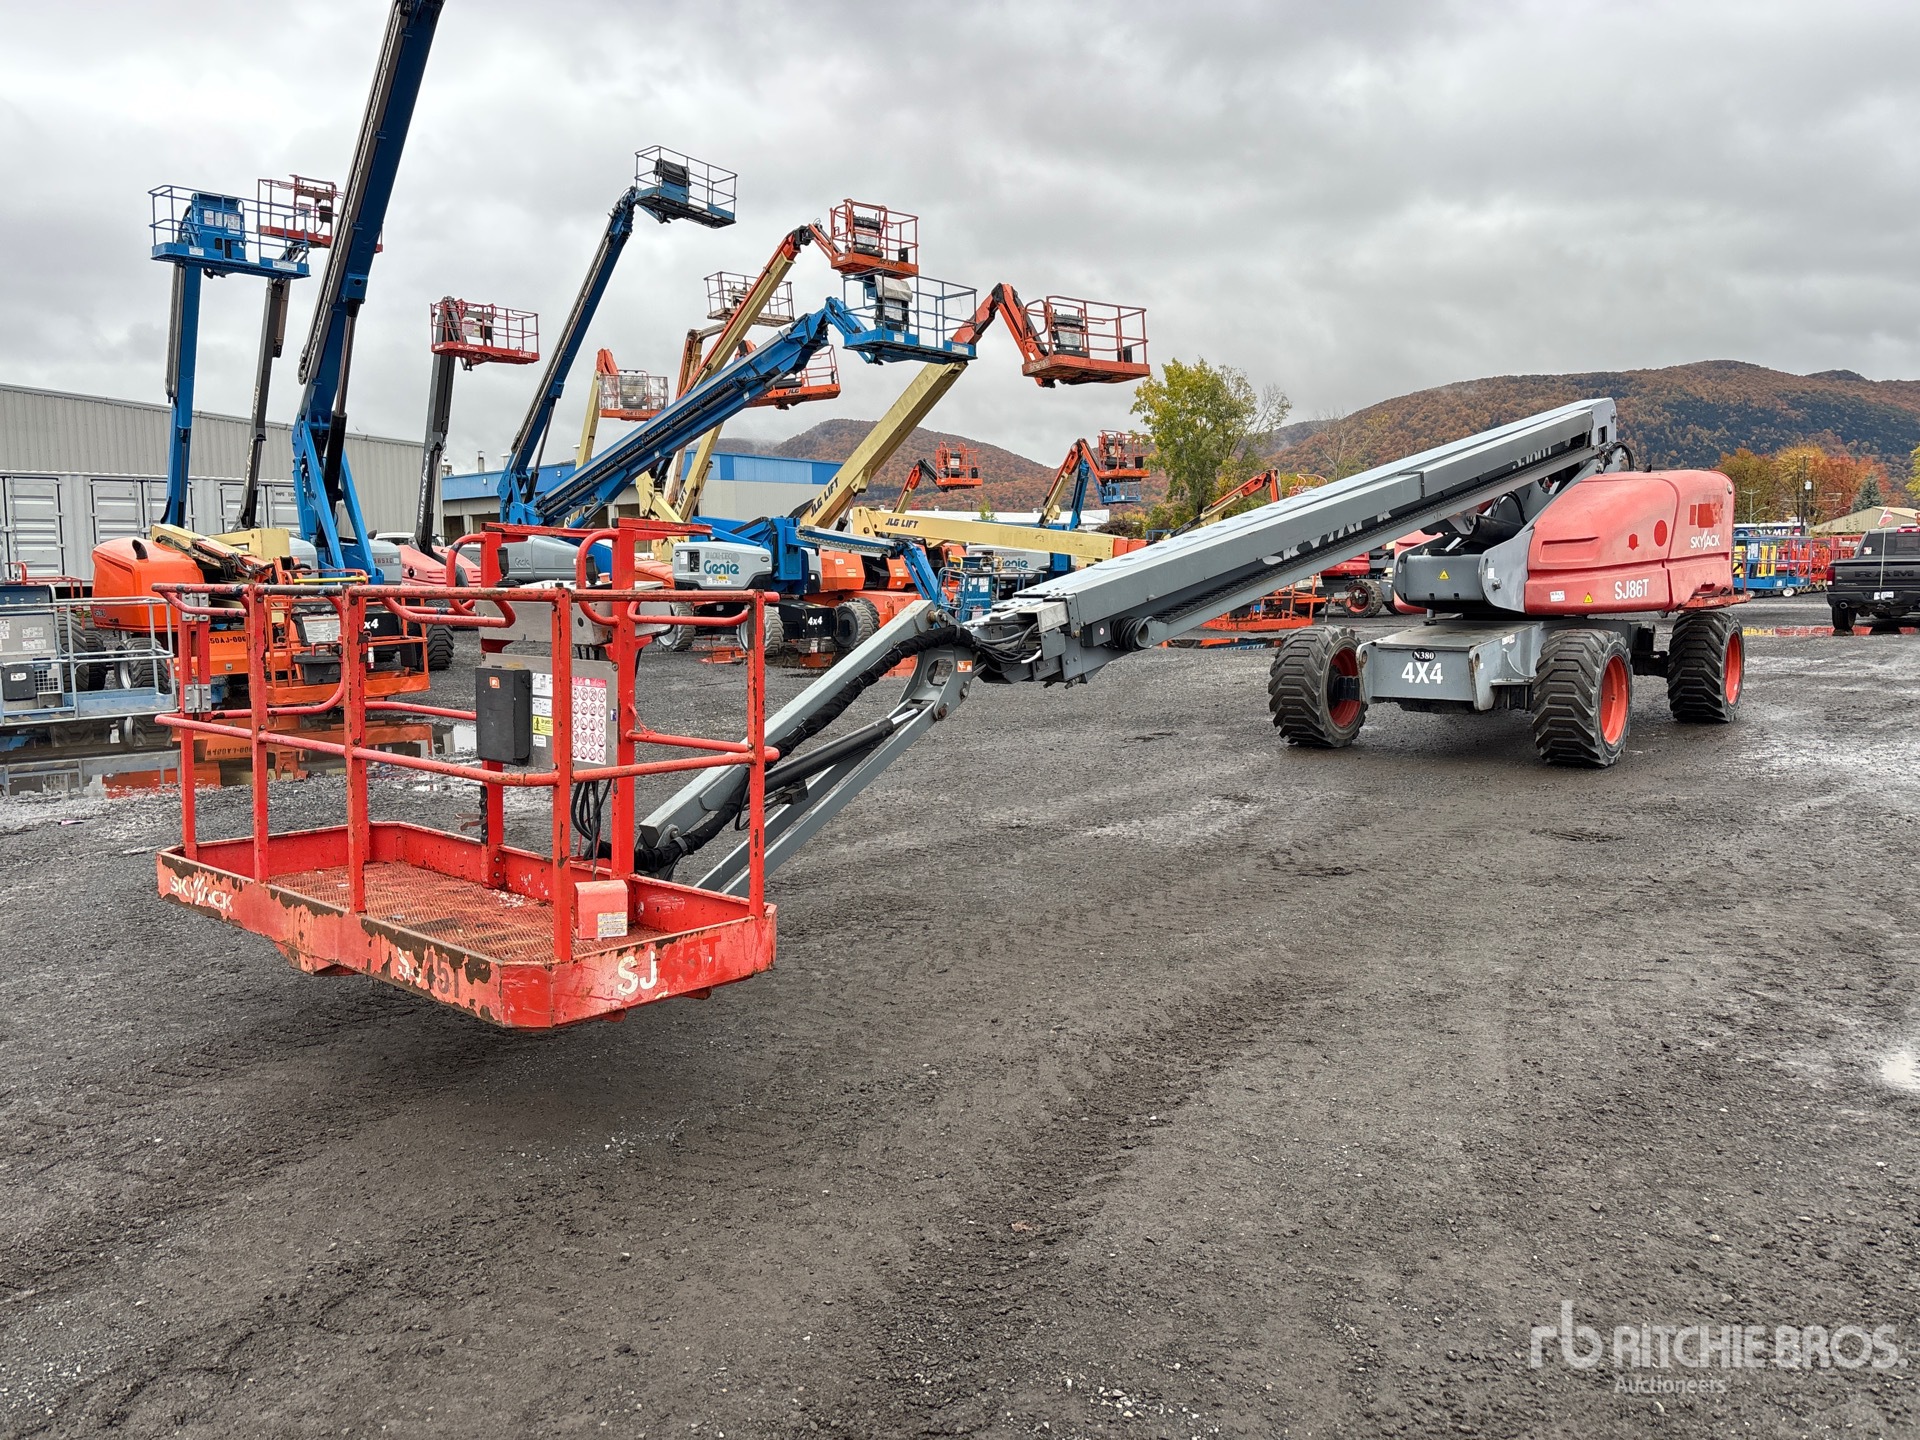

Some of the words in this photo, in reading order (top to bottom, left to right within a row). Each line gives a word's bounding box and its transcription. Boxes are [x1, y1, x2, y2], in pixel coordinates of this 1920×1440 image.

[810, 496, 823, 518] JLG
[823, 476, 838, 502] LIFT
[885, 517, 900, 527] JLG
[900, 519, 919, 529] LIFT
[1690, 529, 1720, 551] SKYJACK
[703, 559, 740, 575] Genie
[1002, 557, 1029, 568] enie
[1854, 569, 1915, 578] RAM
[1614, 578, 1650, 601] SJ86T
[363, 618, 379, 630] x4
[807, 615, 823, 626] 4x4
[1413, 651, 1435, 660] N380
[1401, 661, 1444, 685] 4X4
[169, 874, 234, 913] SKYJACK
